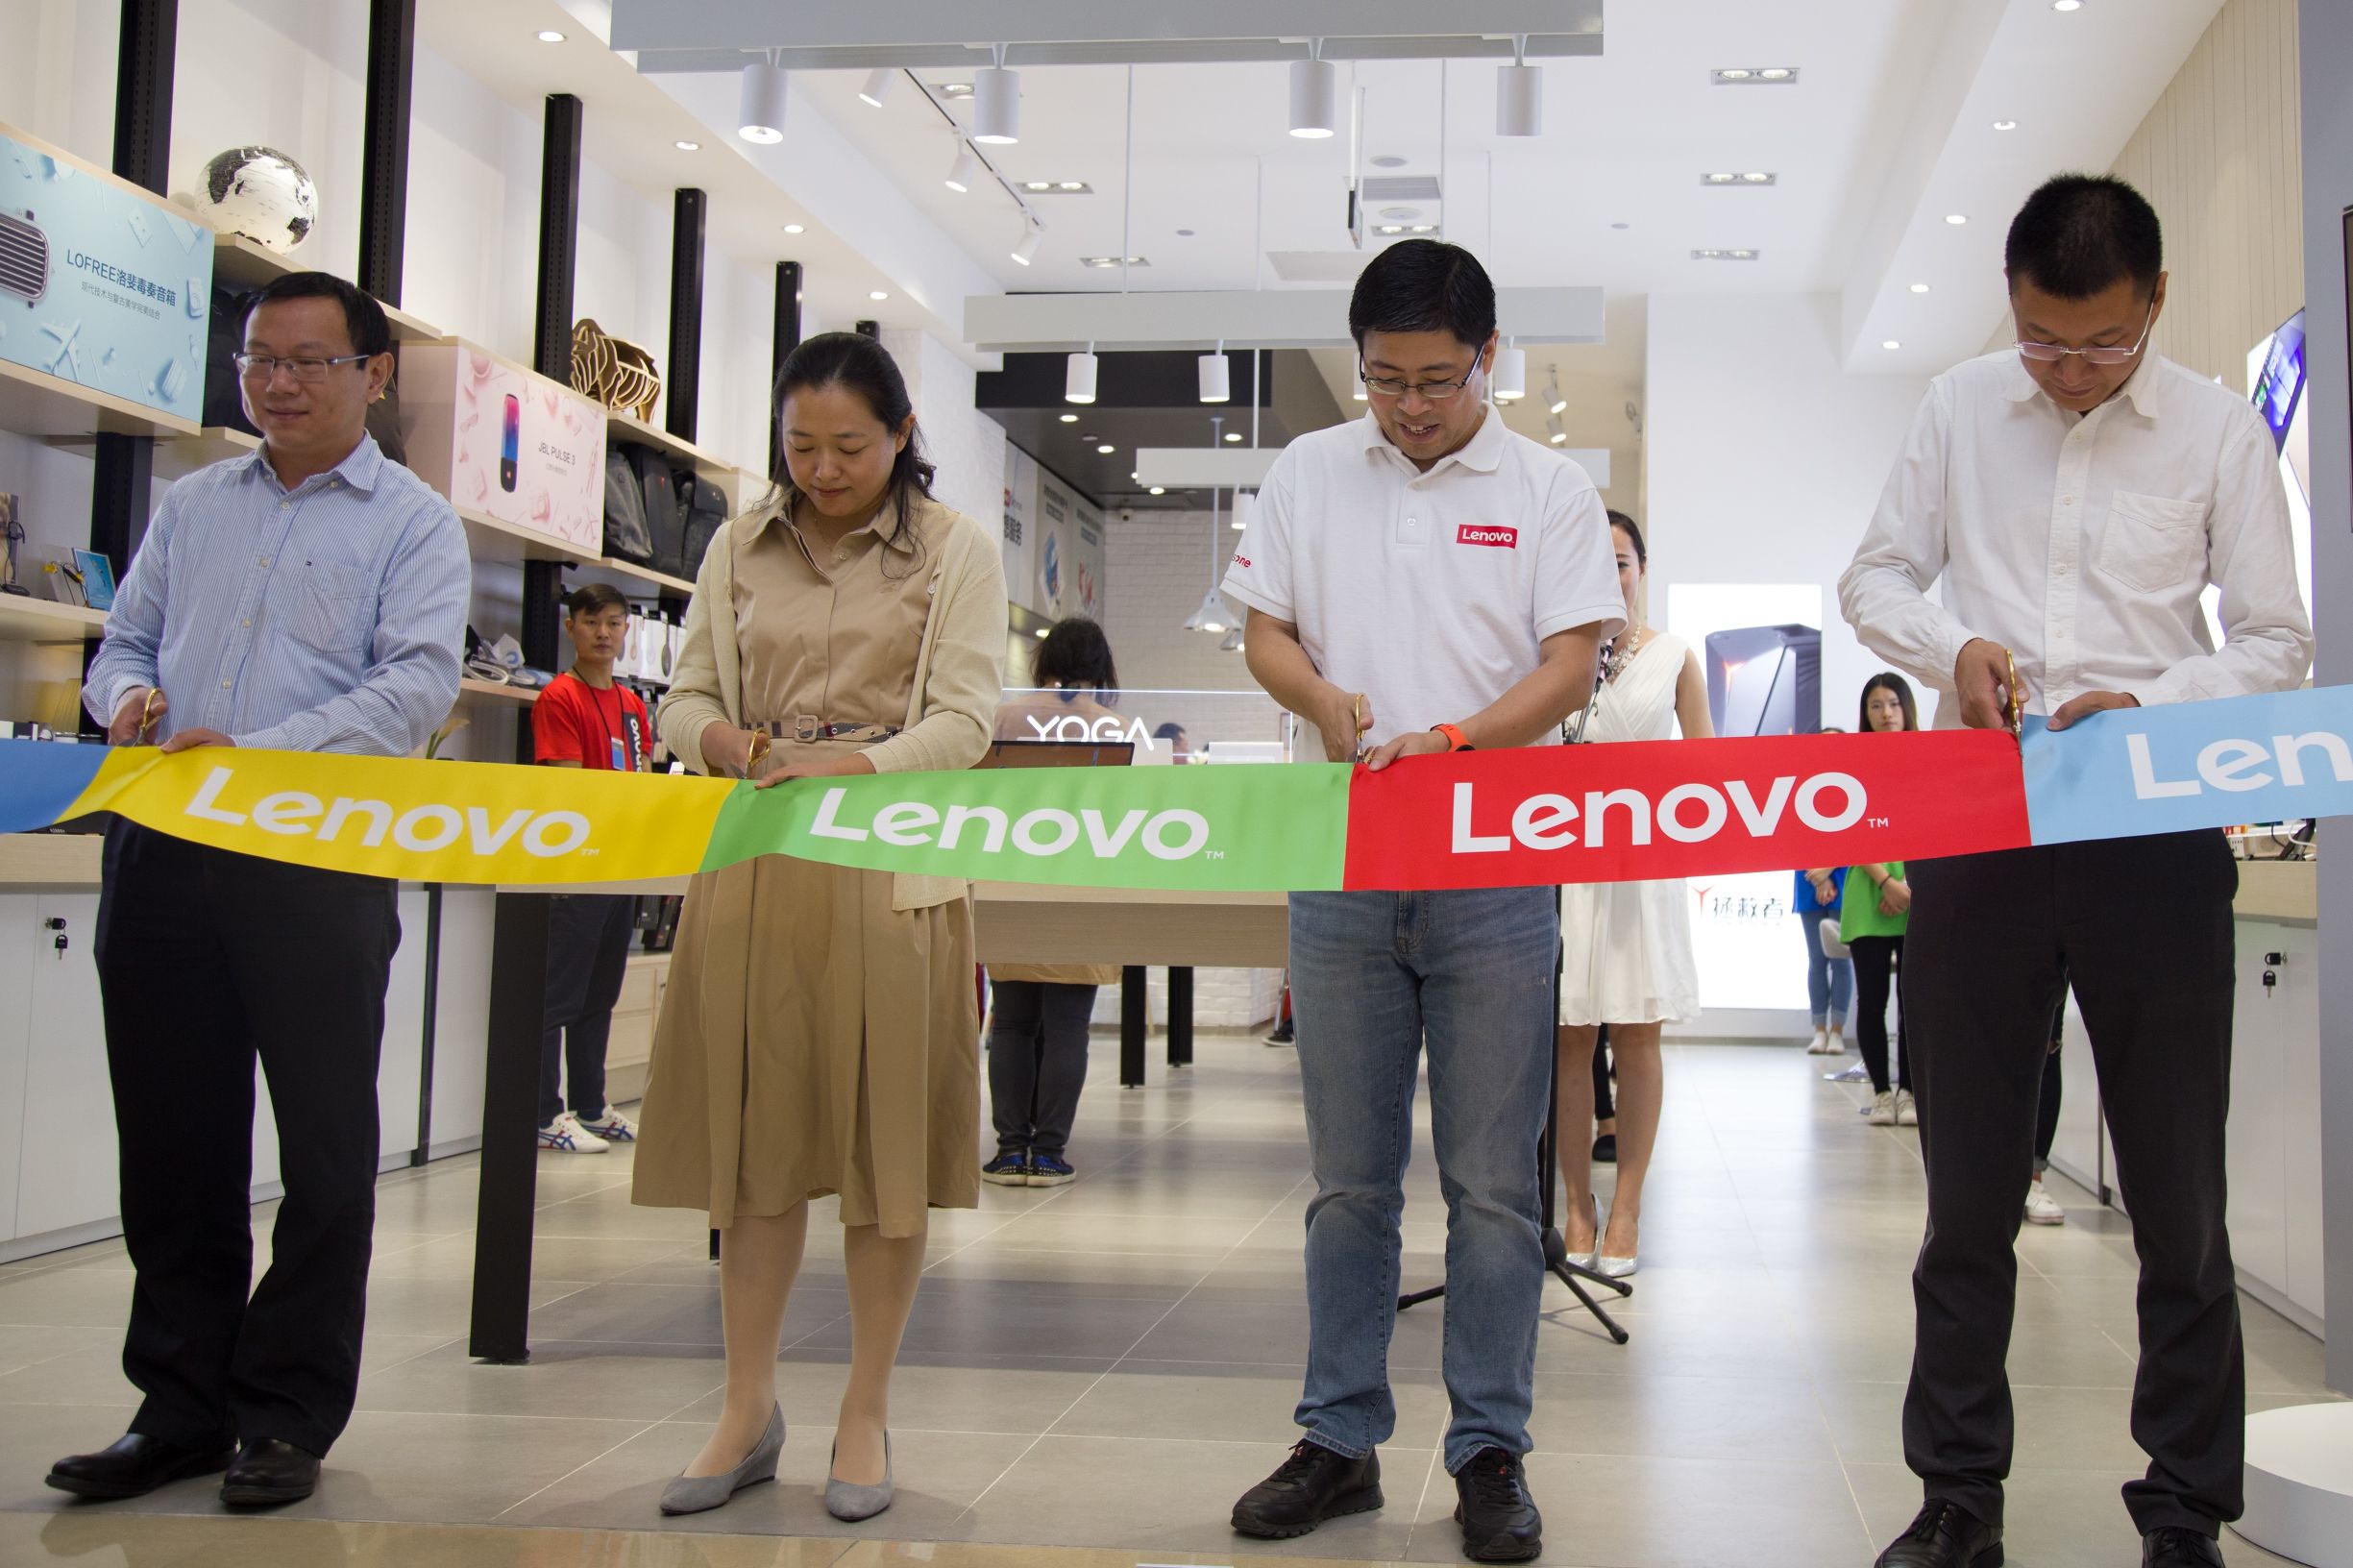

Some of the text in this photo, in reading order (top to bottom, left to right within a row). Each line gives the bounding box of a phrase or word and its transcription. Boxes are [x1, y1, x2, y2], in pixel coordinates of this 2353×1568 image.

[539, 442, 550, 455] JBL
[551, 446, 571, 463] PULSE
[1461, 527, 1513, 543] Lenovo
[1026, 714, 1155, 751] YOGA
[184, 766, 590, 857] Lenovo
[808, 787, 1210, 861] Lenovo
[1452, 772, 1867, 853] Lenovo
[1713, 896, 1784, 919] 拯救者
